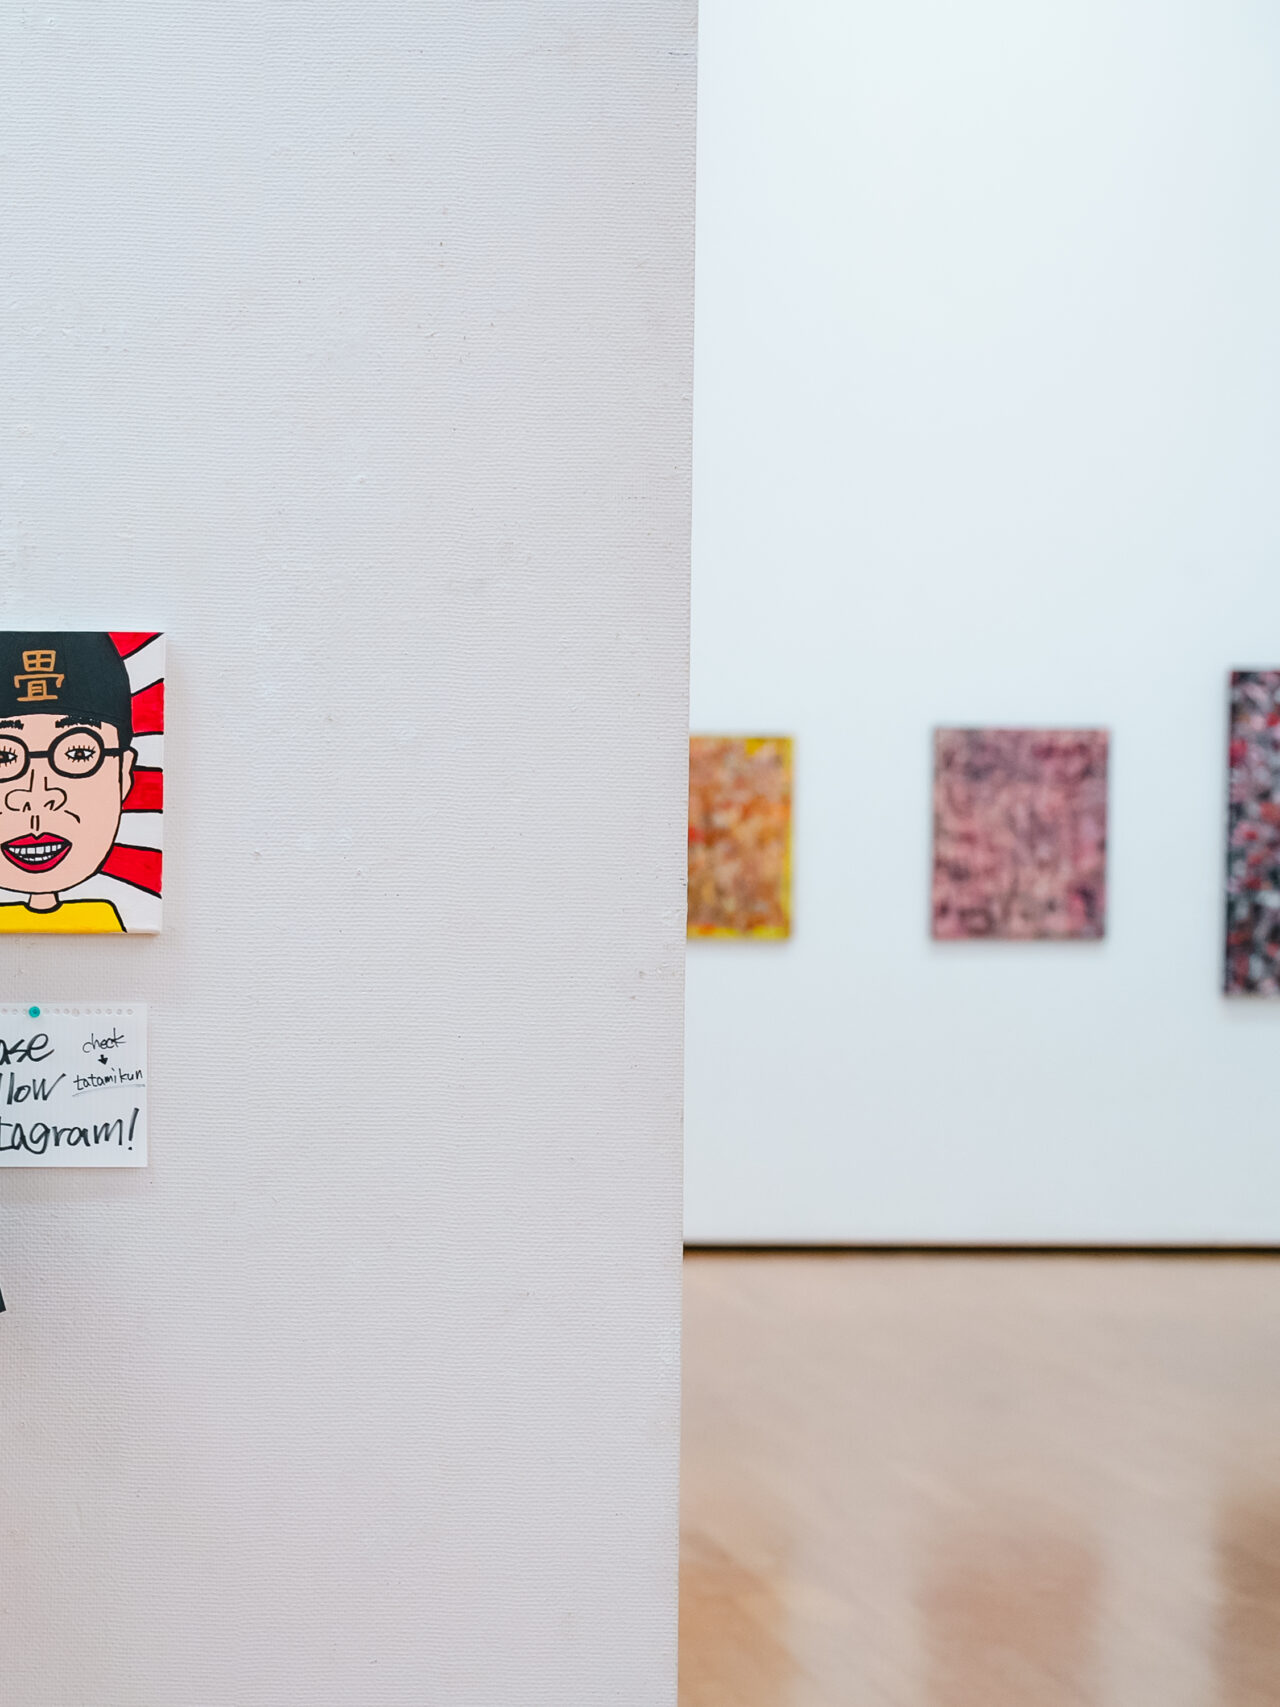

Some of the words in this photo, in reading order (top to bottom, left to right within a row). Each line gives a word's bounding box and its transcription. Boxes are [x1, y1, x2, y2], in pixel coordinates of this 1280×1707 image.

[14, 650, 64, 701] 畳
[82, 1027, 127, 1053] check
[73, 1068, 144, 1091] tatamikun
